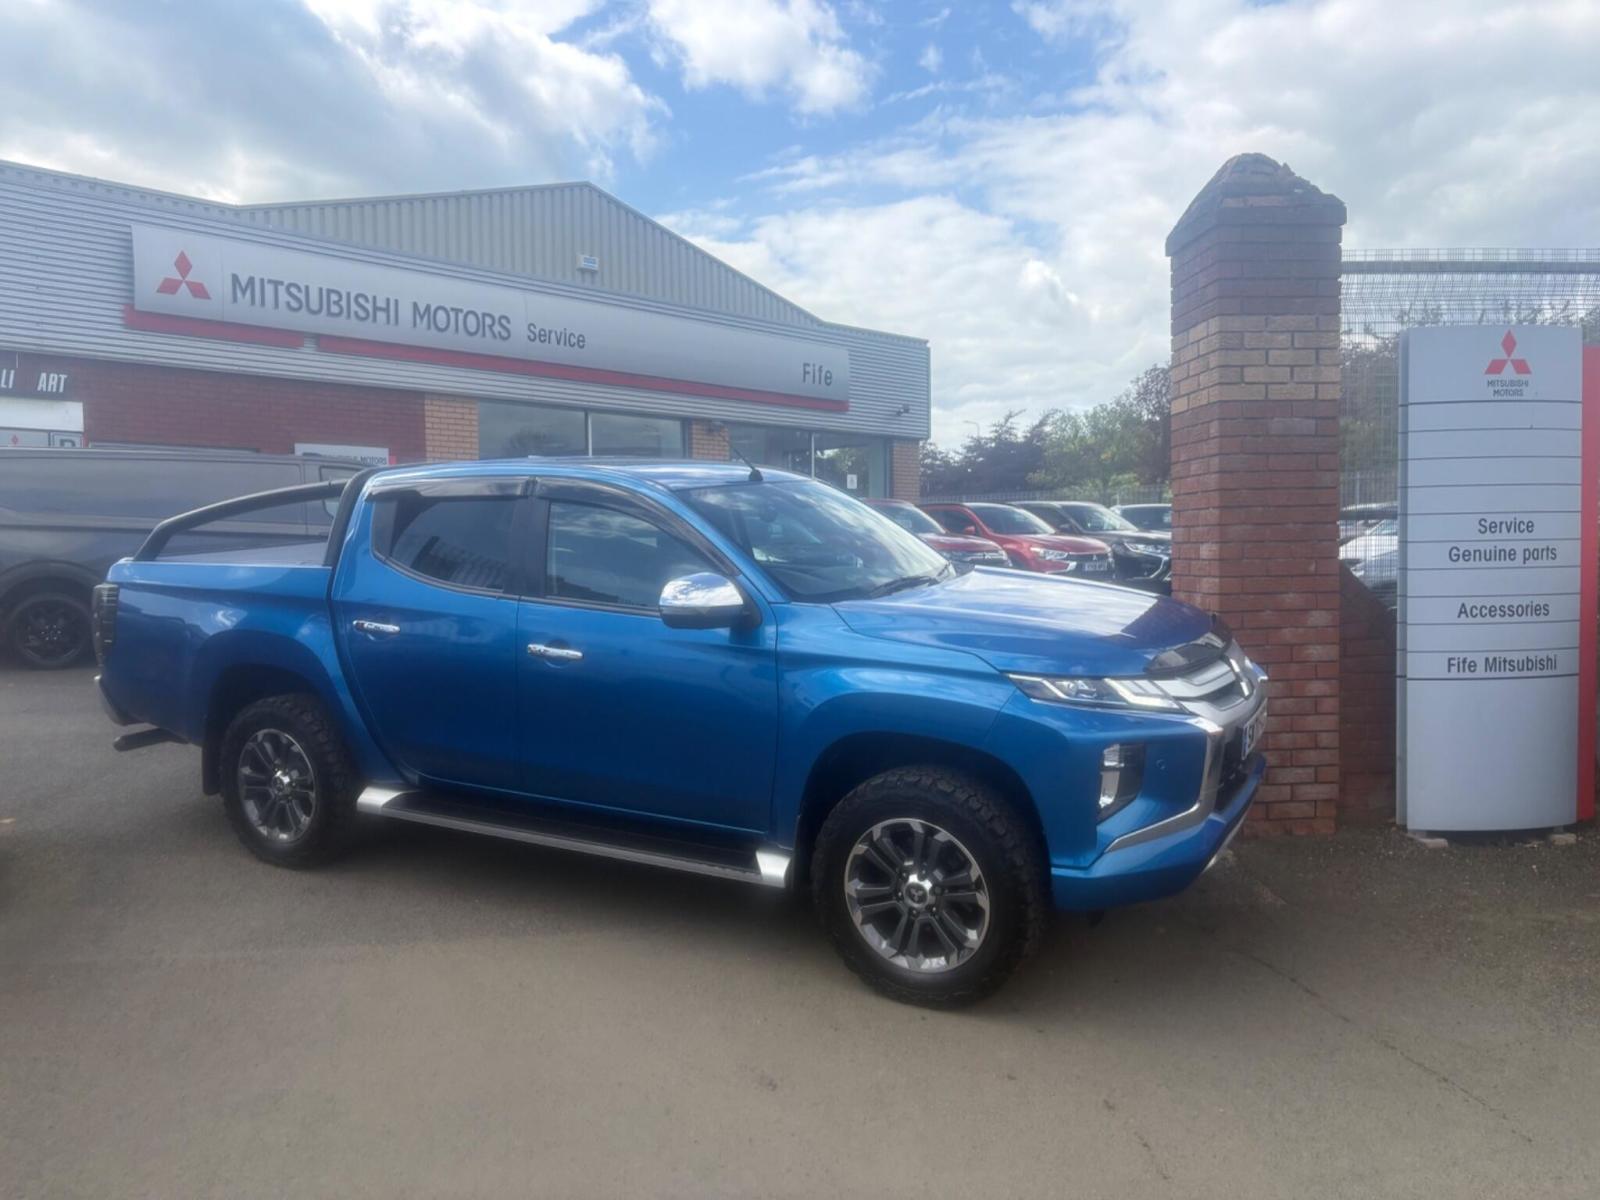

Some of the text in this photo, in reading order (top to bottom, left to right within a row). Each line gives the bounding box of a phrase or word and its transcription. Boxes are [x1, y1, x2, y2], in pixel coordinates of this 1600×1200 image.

[231, 273, 586, 350] MITSUBISHI MOTORS Service
[37, 372, 68, 393] ART
[802, 362, 833, 386] Fife
[1487, 379, 1529, 388] MITSUBISHI
[1492, 388, 1524, 397] MOTORS
[1477, 517, 1535, 534] Service
[1448, 545, 1557, 564] Genuine parts
[1457, 601, 1550, 619] Accessories
[1447, 654, 1558, 674] Fife Mitsubishi
